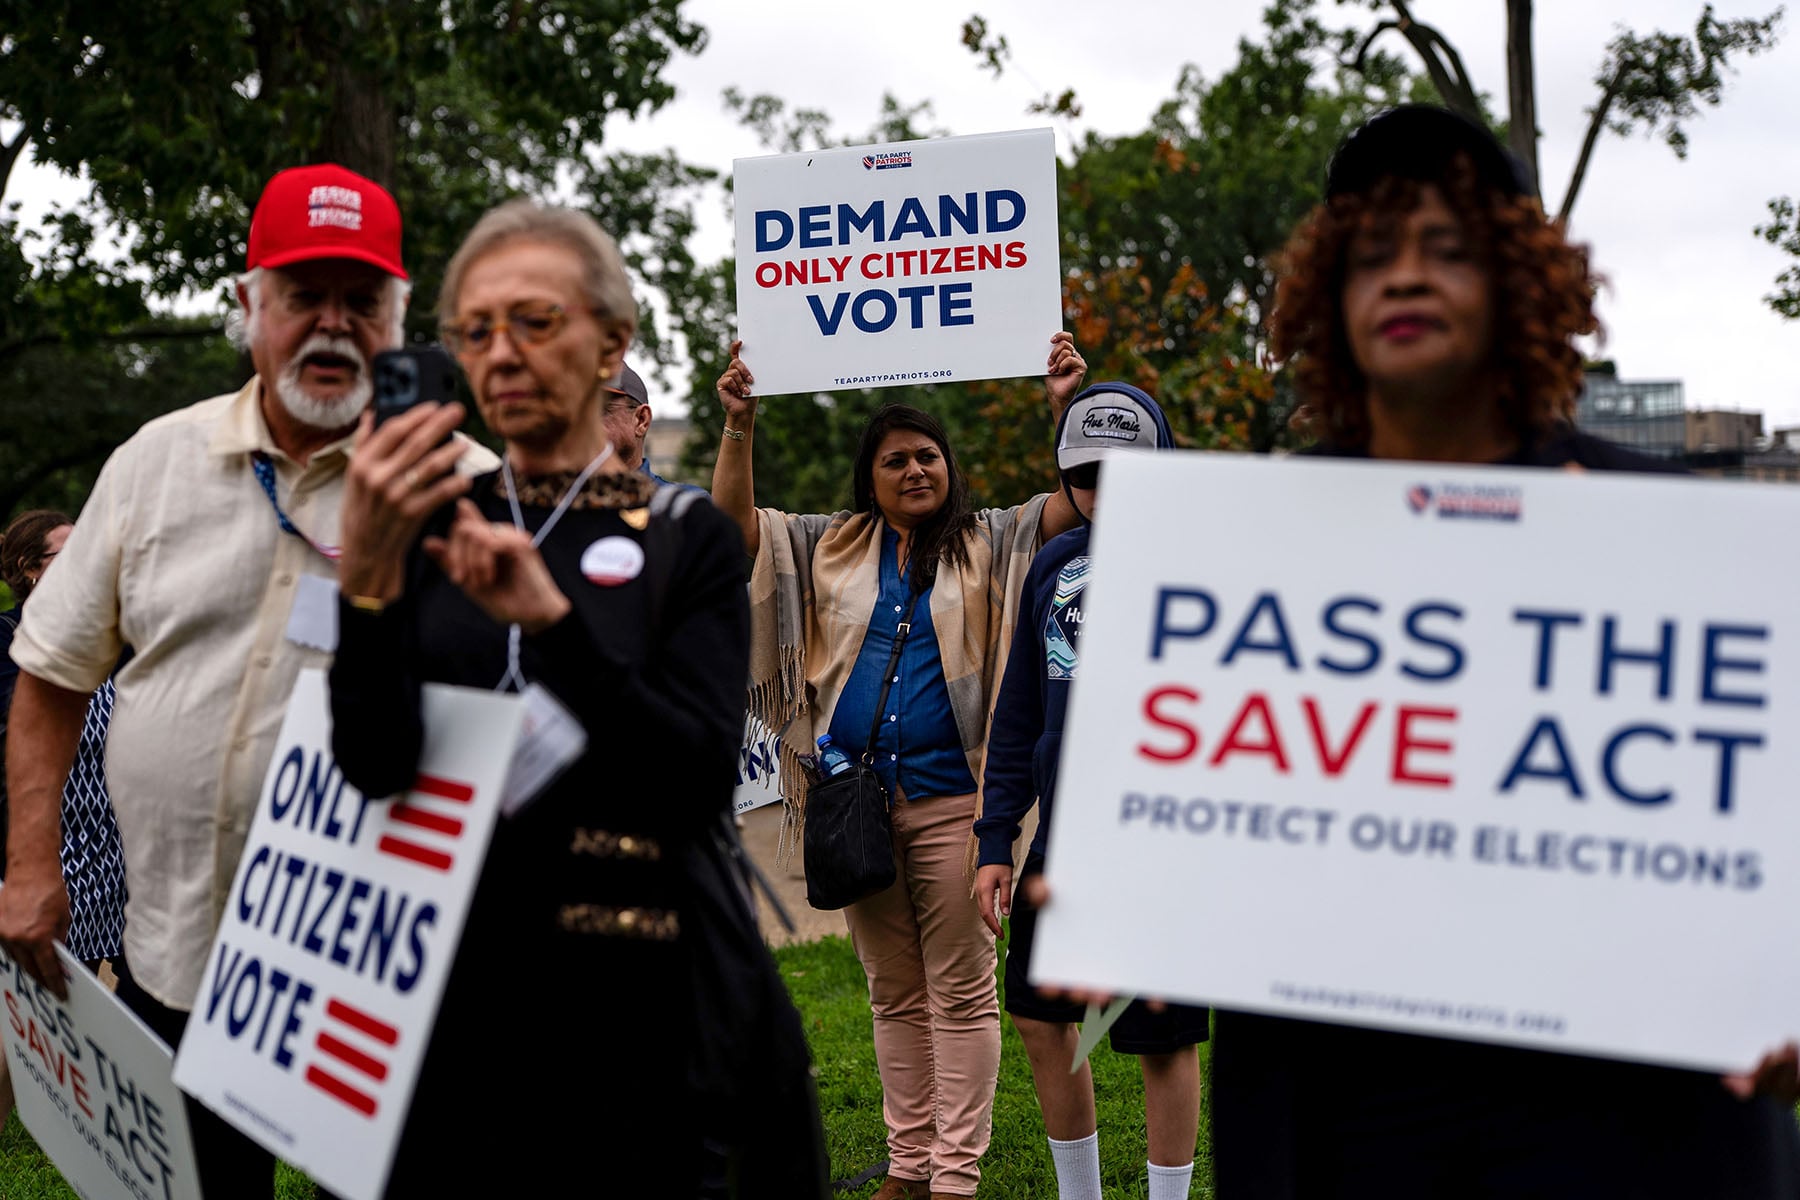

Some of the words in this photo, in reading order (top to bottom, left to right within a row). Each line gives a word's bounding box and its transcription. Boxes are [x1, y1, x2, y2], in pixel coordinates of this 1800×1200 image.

[876, 157, 912, 165] PATRIOTS
[755, 189, 1027, 252] DEMAND
[755, 256, 852, 288] ONLY
[860, 241, 1027, 280] CITIZENS
[806, 282, 974, 336] VOTE
[834, 369, 952, 385] TEAPARTYPATRIOTS.ORG
[1082, 413, 1104, 430] Ave
[1107, 413, 1140, 432] Maria
[1065, 607, 1087, 623] Hu
[1147, 584, 1470, 684] PASS
[1512, 607, 1772, 709] THE
[1136, 684, 1460, 789] SAVE
[1495, 715, 1768, 815] ACT
[1118, 792, 1338, 845] PROTECT
[1349, 811, 1459, 861] OUR
[1473, 825, 1766, 892] ELECTIONS
[236, 845, 439, 994] CITIZENS
[205, 943, 317, 1071] VOTE
[0, 958, 81, 1062] ASS
[84, 1034, 170, 1157] THE
[4, 989, 94, 1120] SAVE
[105, 1102, 174, 1200] ACT
[72, 1112, 102, 1158] OUR
